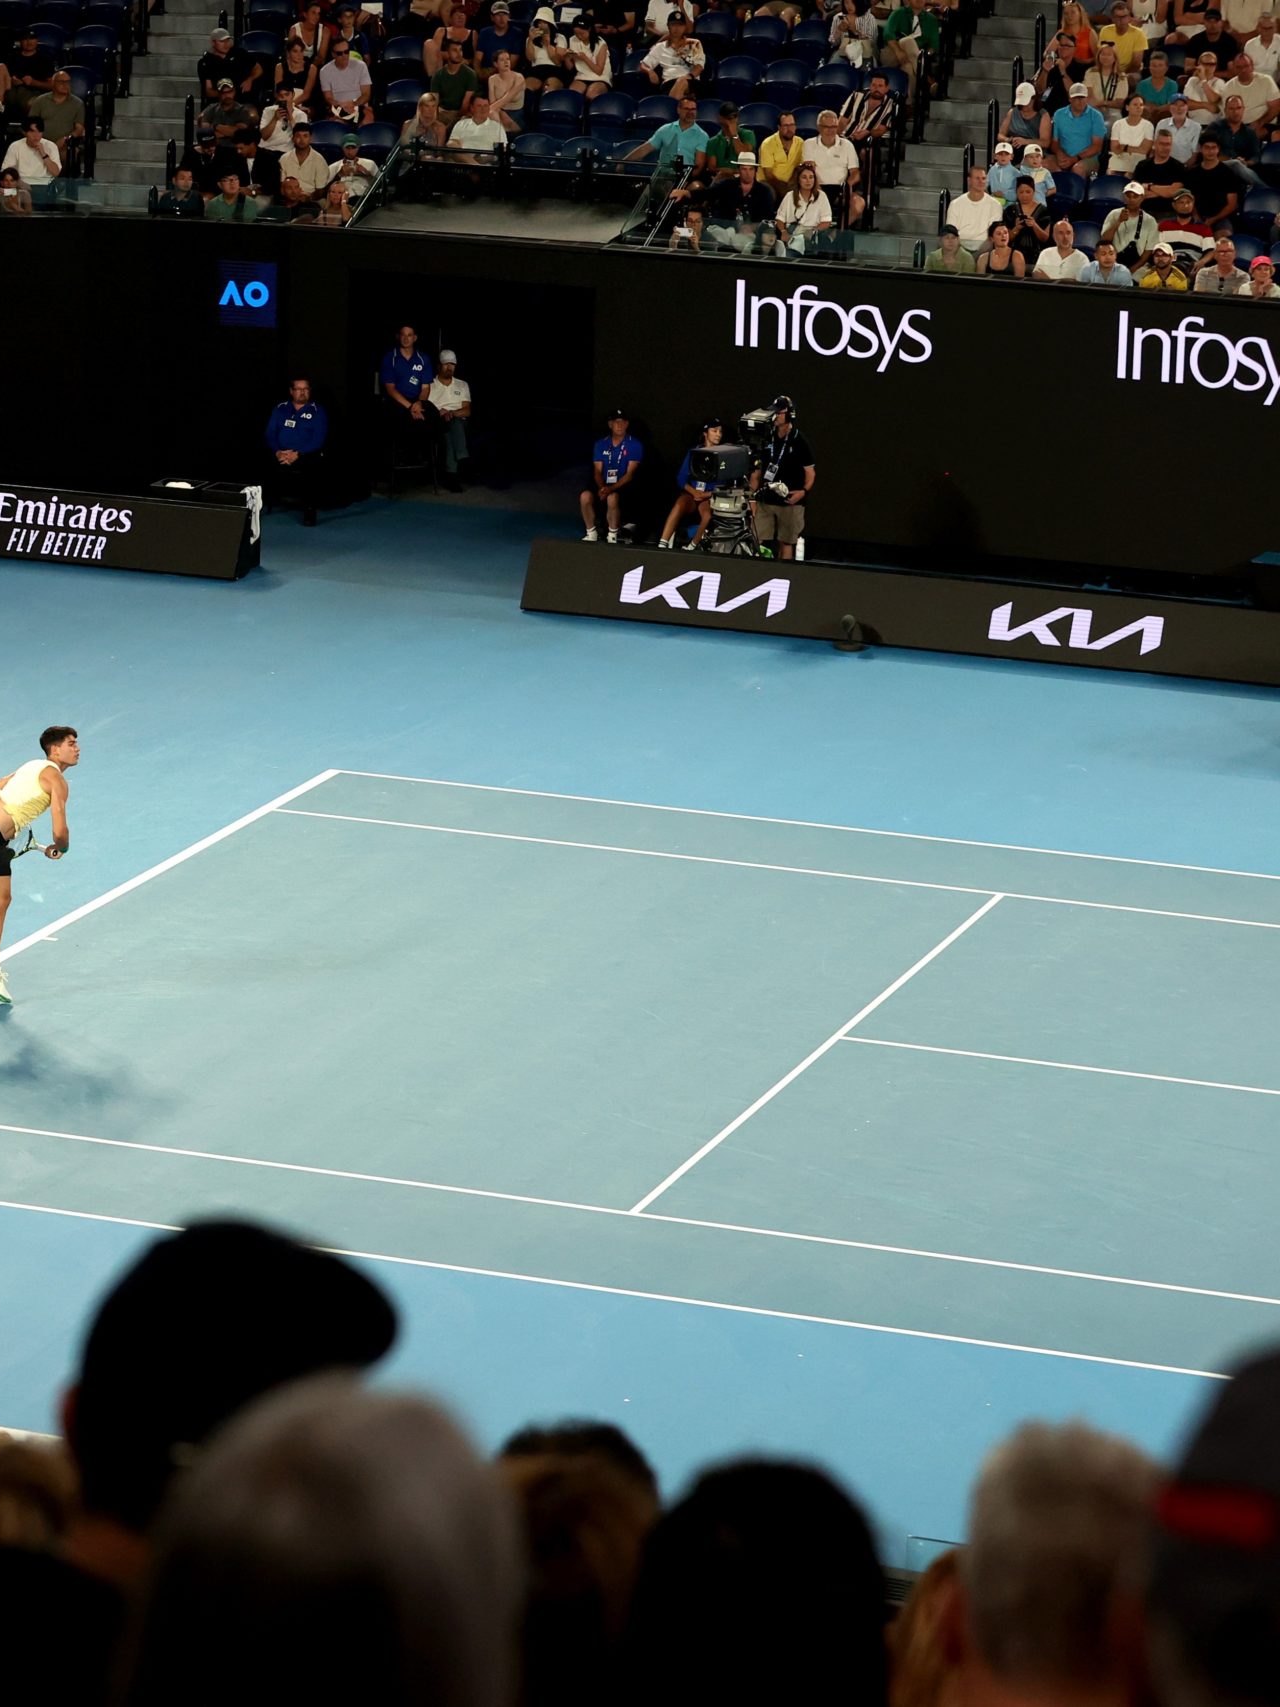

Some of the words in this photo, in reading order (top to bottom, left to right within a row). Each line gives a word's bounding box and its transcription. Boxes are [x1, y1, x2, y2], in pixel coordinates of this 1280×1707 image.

[219, 280, 270, 308] AO
[736, 279, 933, 373] Infosys
[1117, 310, 1280, 406] Infosy
[7, 527, 40, 553] FLY
[41, 531, 107, 560] BETTER
[620, 566, 791, 618] KIA
[988, 601, 1165, 656] KIA
